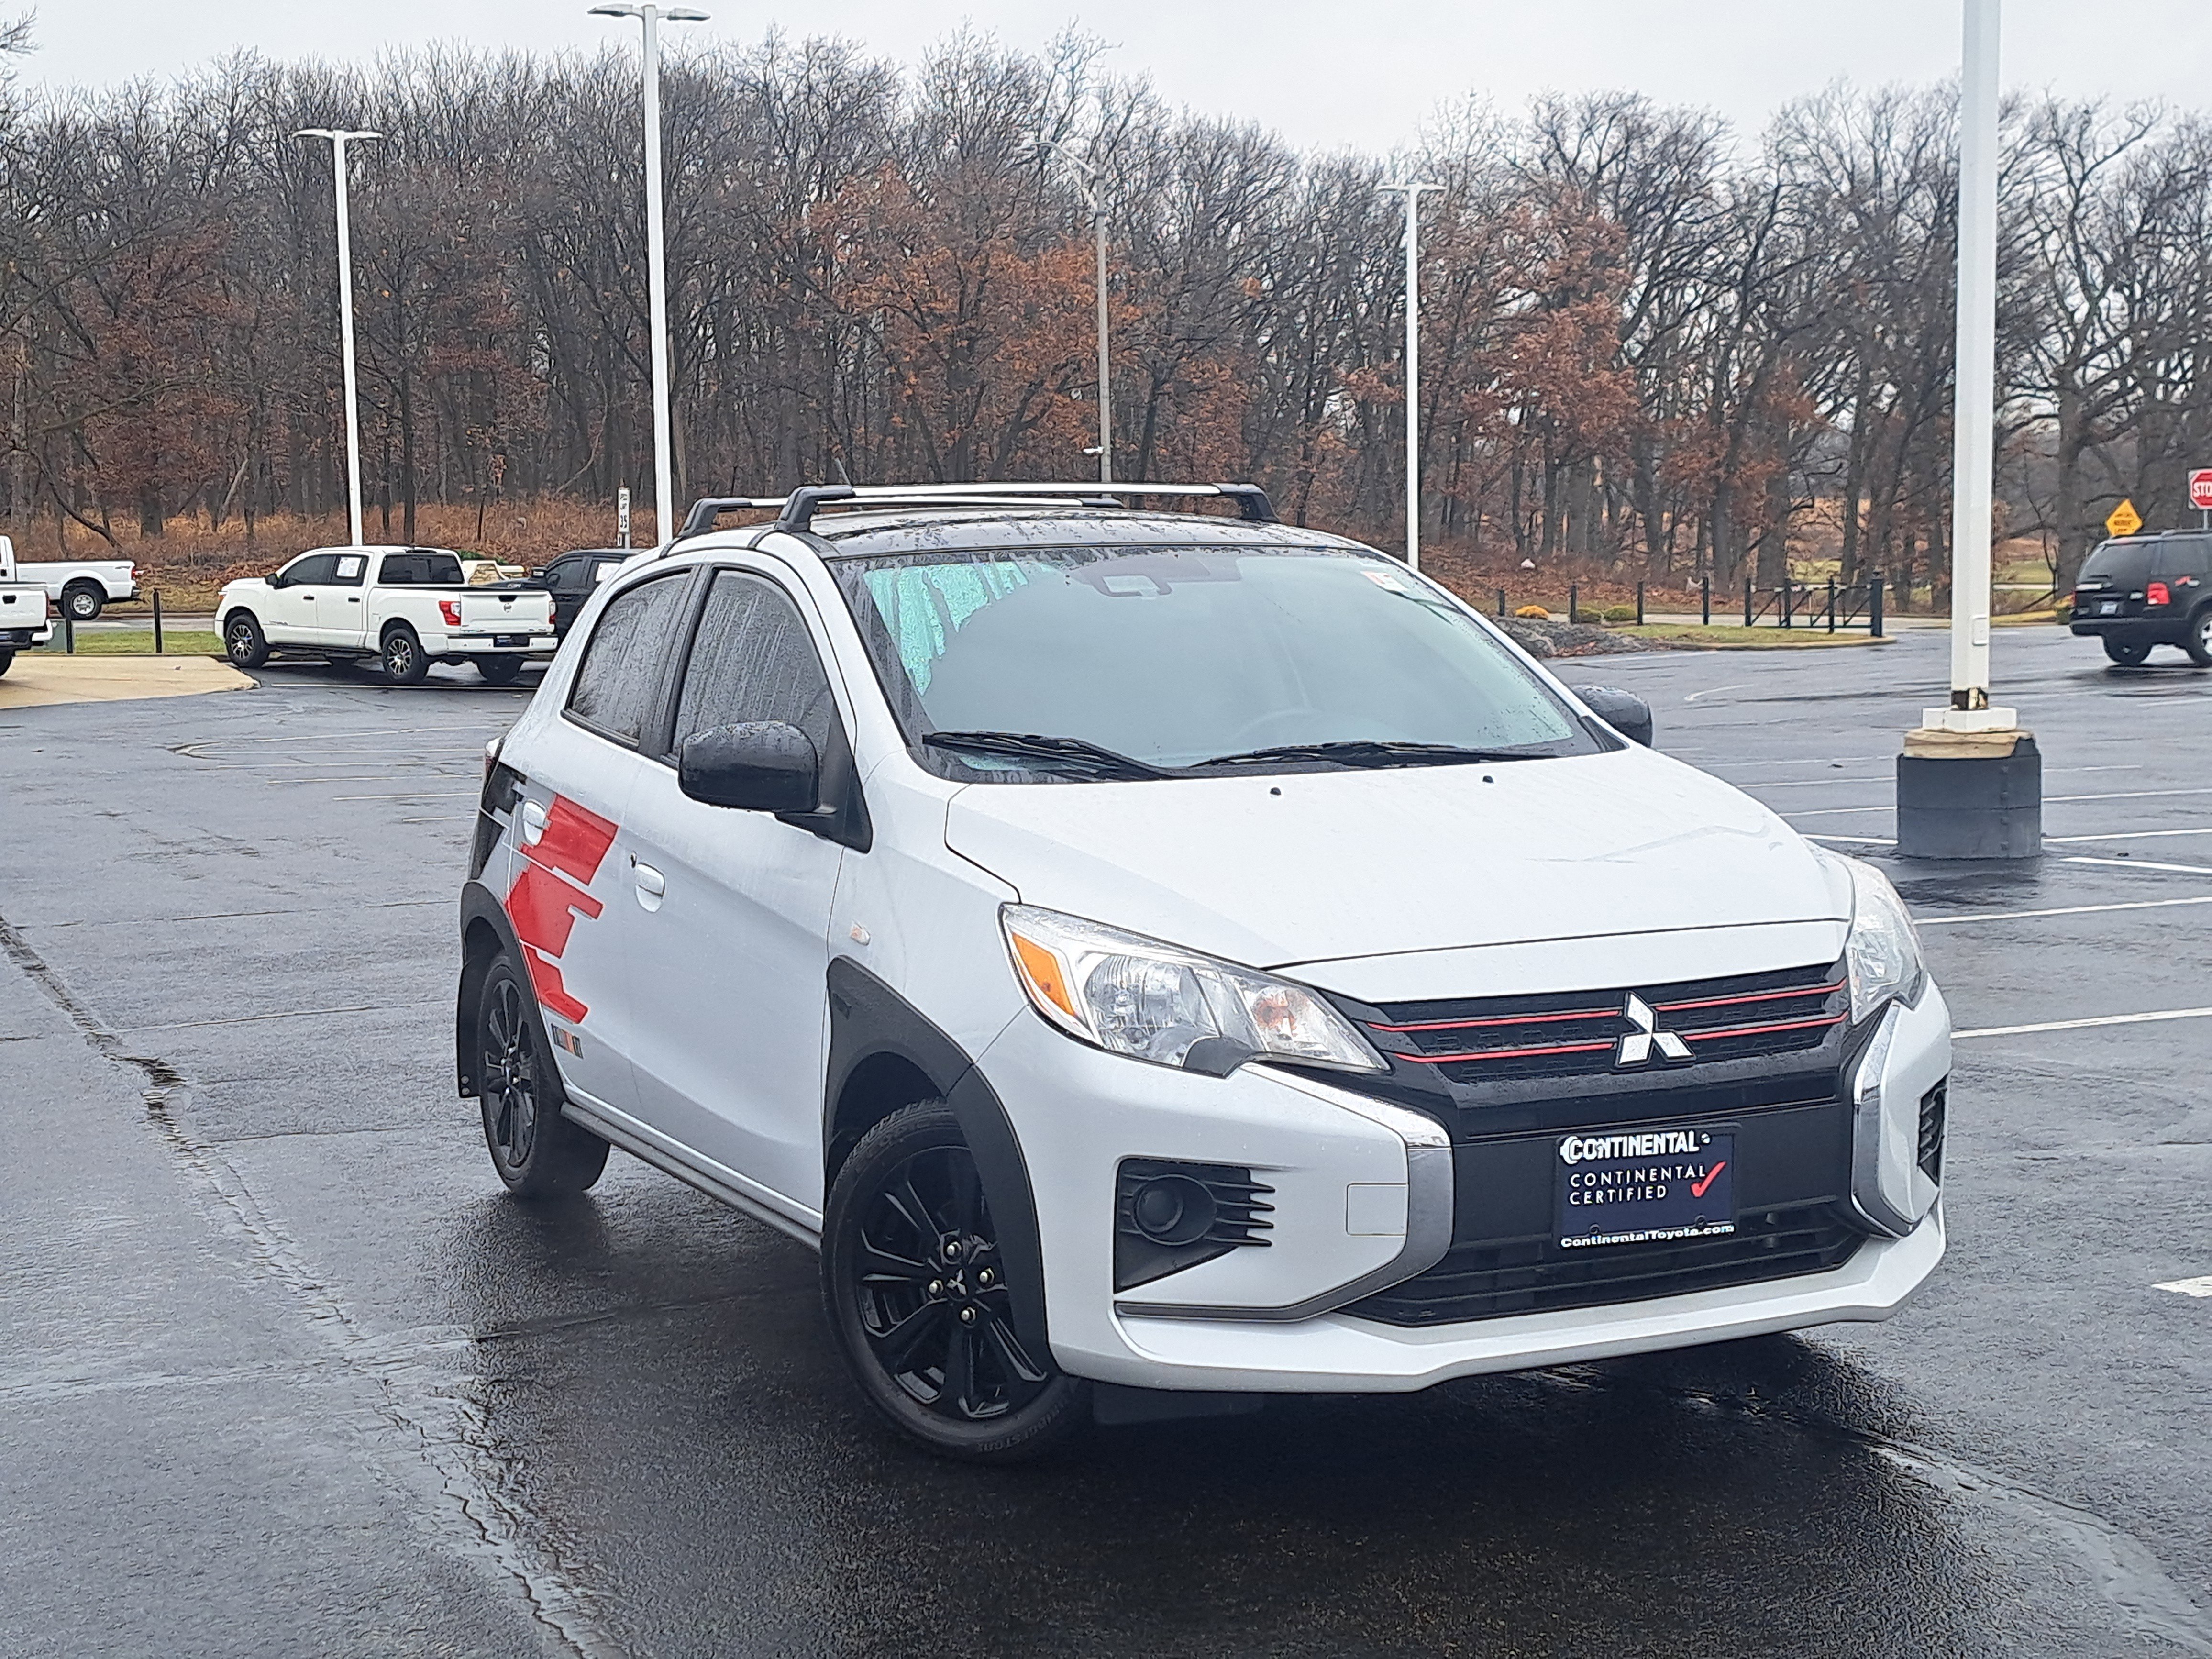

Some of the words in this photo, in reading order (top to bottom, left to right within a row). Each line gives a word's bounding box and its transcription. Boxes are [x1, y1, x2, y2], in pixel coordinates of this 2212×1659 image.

[2193, 482, 2212, 497] STO
[1560, 1130, 1700, 1164] CONTINENTAL
[1570, 1163, 1706, 1187] CONTINENTAL
[1570, 1185, 1667, 1205] CERTIFIED
[1560, 1225, 1734, 1248] ContinentalToyota.com
